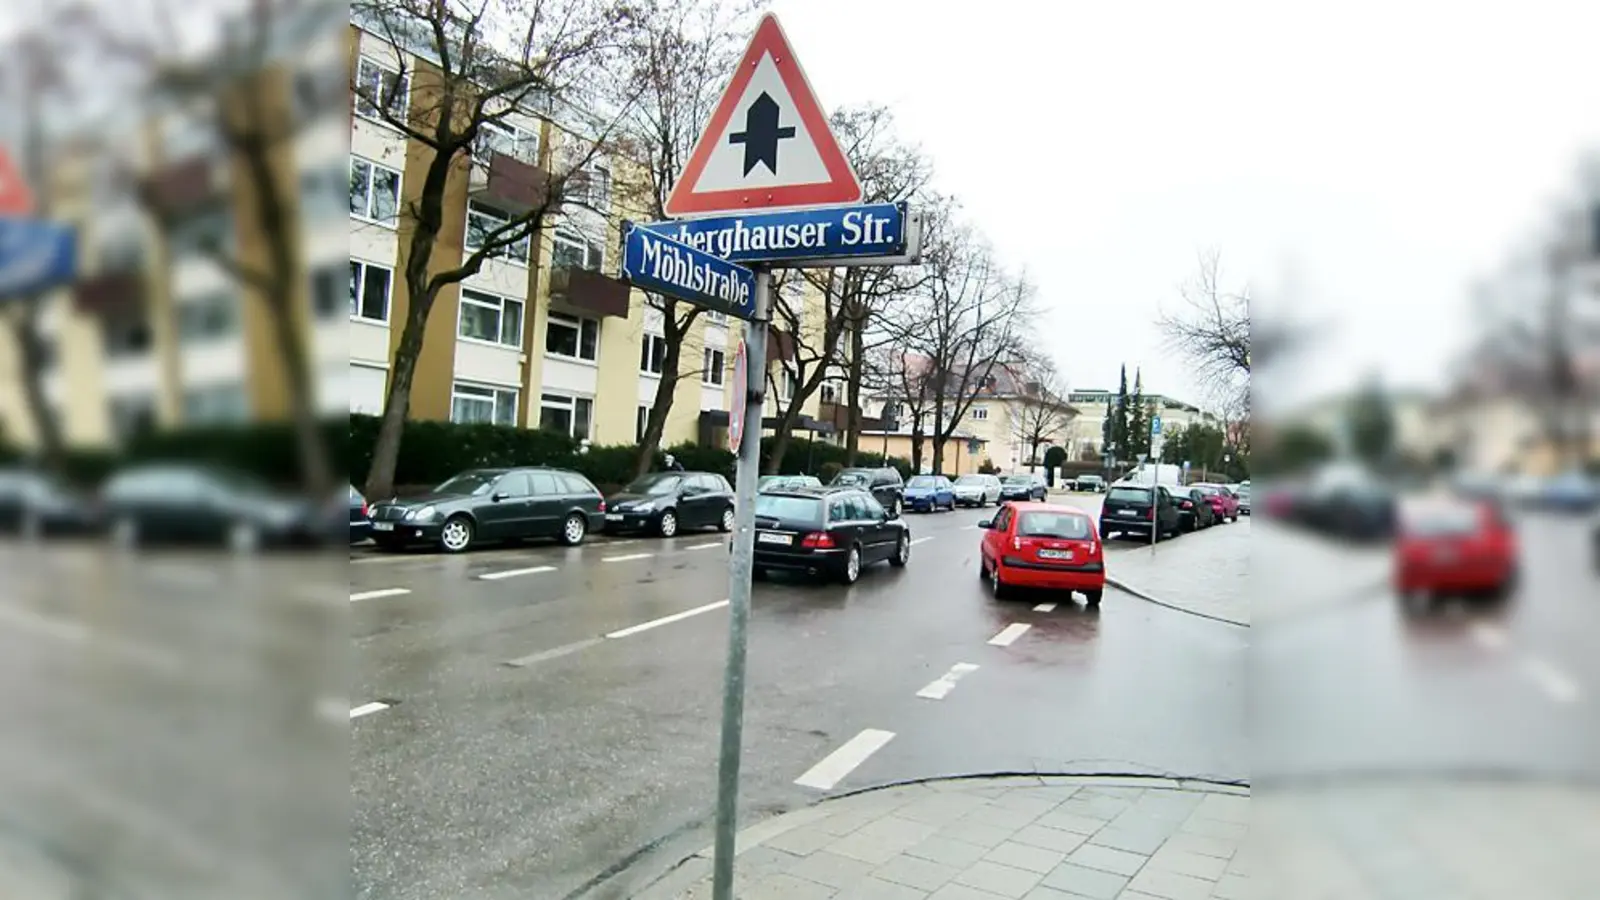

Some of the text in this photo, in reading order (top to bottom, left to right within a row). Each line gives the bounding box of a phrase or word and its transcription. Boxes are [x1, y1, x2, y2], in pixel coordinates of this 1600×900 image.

[668, 210, 894, 260] berghauser Str.
[639, 234, 749, 308] Möhlstraße
